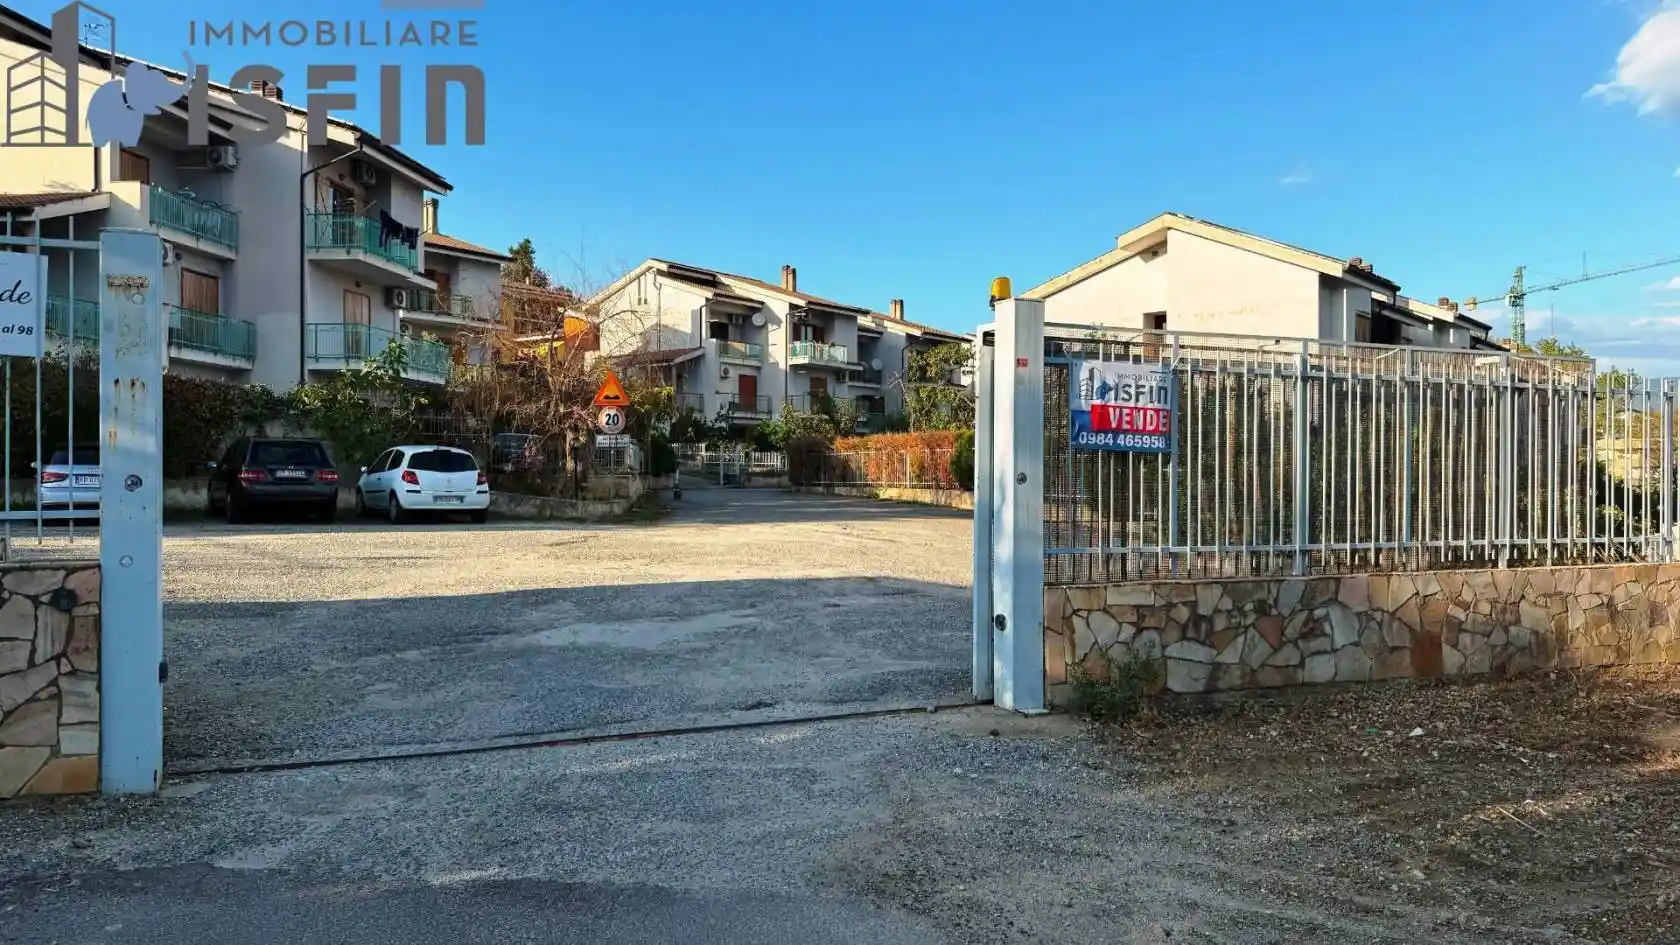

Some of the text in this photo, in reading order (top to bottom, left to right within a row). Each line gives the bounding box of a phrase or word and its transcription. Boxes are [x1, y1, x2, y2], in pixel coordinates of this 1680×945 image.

[17, 325, 34, 336] 98
[605, 413, 619, 426] 20
[1108, 407, 1167, 431] VENDE
[1079, 432, 1166, 449] 0984 465958
